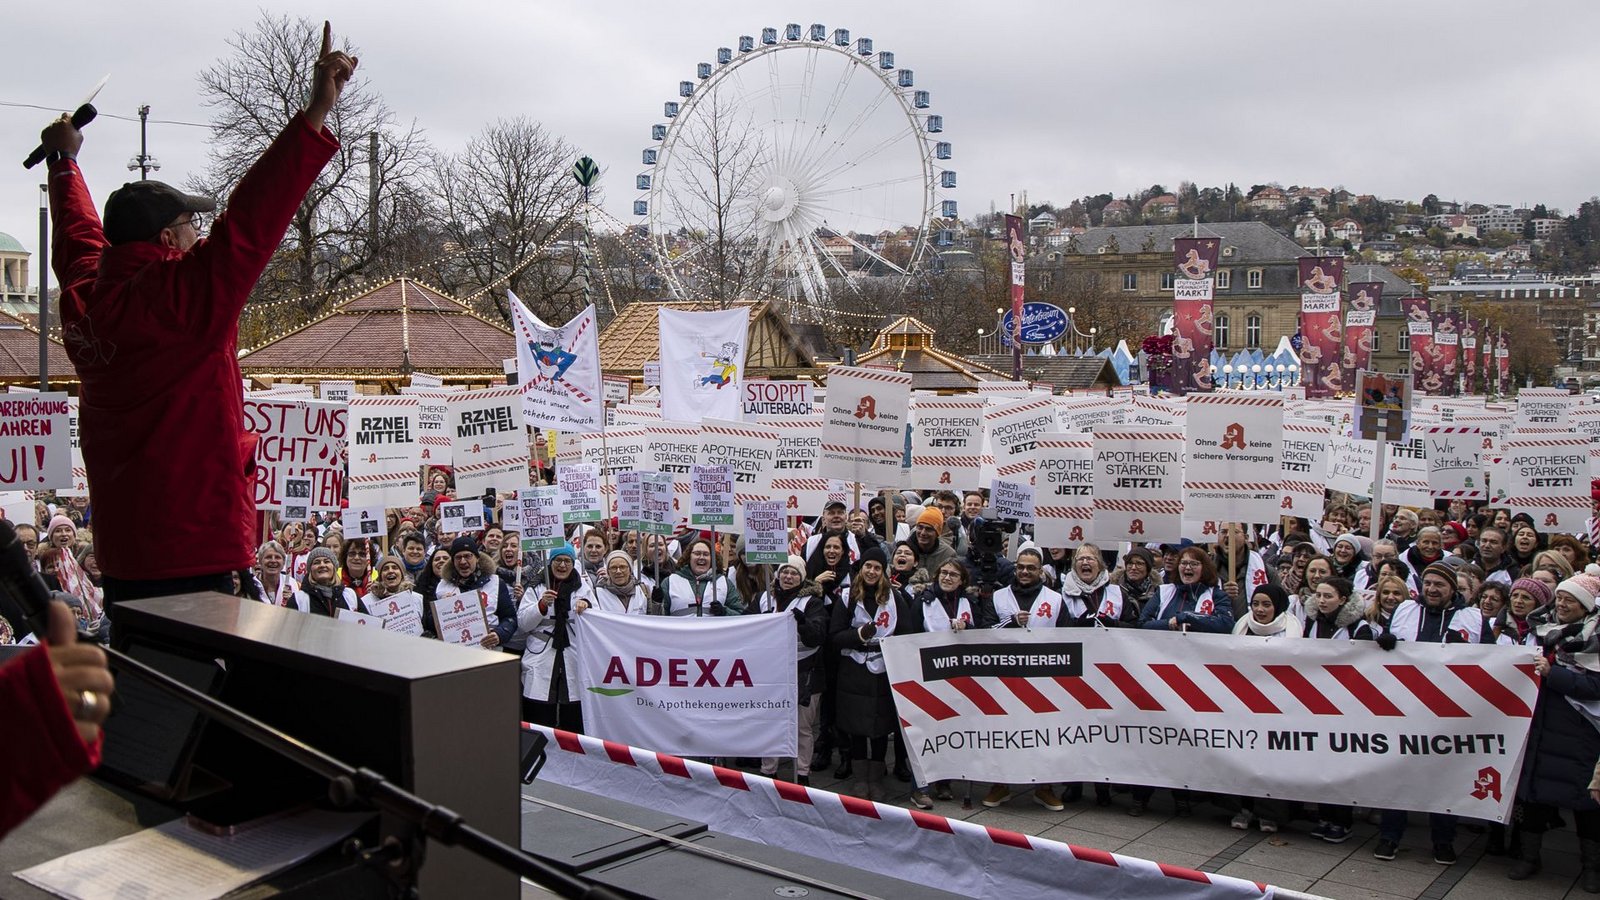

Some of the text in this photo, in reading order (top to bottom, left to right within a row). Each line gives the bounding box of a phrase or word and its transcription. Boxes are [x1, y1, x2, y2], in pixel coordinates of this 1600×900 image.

[1176, 289, 1209, 297] MARKT
[1303, 302, 1335, 310] MARKT
[746, 383, 807, 402] STOPPT
[743, 402, 813, 415] LAUTERBACH
[1520, 402, 1567, 410] APOTHEKEN
[461, 406, 512, 425] RZNEI
[560, 415, 594, 424] schwach
[832, 406, 852, 415] Ohne
[879, 412, 899, 421] keine
[1071, 410, 1110, 421] APOTHEKEN
[303, 407, 348, 439] UNS
[361, 417, 409, 431] RZNEI
[457, 418, 519, 438] MITTEL
[829, 419, 899, 434] sichere Versorgung
[917, 417, 980, 427] APOTHEKEN
[991, 415, 1054, 437] APOTHEKEN
[356, 430, 414, 445] MITTEL
[923, 427, 973, 437] STÄRKEN.
[928, 438, 967, 448] JETZT!
[1194, 438, 1217, 446] Ohne
[1249, 440, 1272, 448] keine
[1328, 440, 1374, 456] Apotheken
[1432, 438, 1456, 454] Wir
[584, 444, 644, 457] APOTHEKEN
[701, 443, 773, 460] APOTHEKEN
[653, 452, 697, 463] STÄRKEN
[823, 453, 854, 462] APOTHEKEN
[1097, 451, 1178, 463] APOTHEKEN
[1192, 453, 1274, 463] sichere Versorgung
[1512, 455, 1586, 466] APOTHEKEN
[658, 464, 691, 474] JETZT
[773, 460, 813, 469] JETZT!
[1105, 464, 1169, 476] STÄRKEN.
[733, 472, 756, 483] ZT!
[1520, 466, 1579, 477] STÄRKEN.
[698, 474, 725, 482] STERBEN
[1113, 477, 1162, 488] JETZT!
[1527, 477, 1573, 487] JETZT!
[254, 465, 344, 507] BLTEN
[693, 480, 732, 494] Stoppen!
[998, 481, 1019, 490] Nach
[997, 489, 1031, 501] SPD light
[695, 500, 730, 508] ARBEITSPLÄTZE
[569, 512, 591, 520] ADEXA
[751, 511, 778, 519] STERBEN
[995, 505, 1032, 518] SPD zero.
[746, 517, 785, 531] Stoppen!
[932, 654, 1071, 669] WIR PROTESTIEREN!
[602, 655, 754, 688] ADEXA
[636, 697, 791, 712] Die Apothekengewerkschaft
[921, 725, 1506, 756] APOTHEKEN KAPUTTSPAREN? MIT UNS NICHT!
